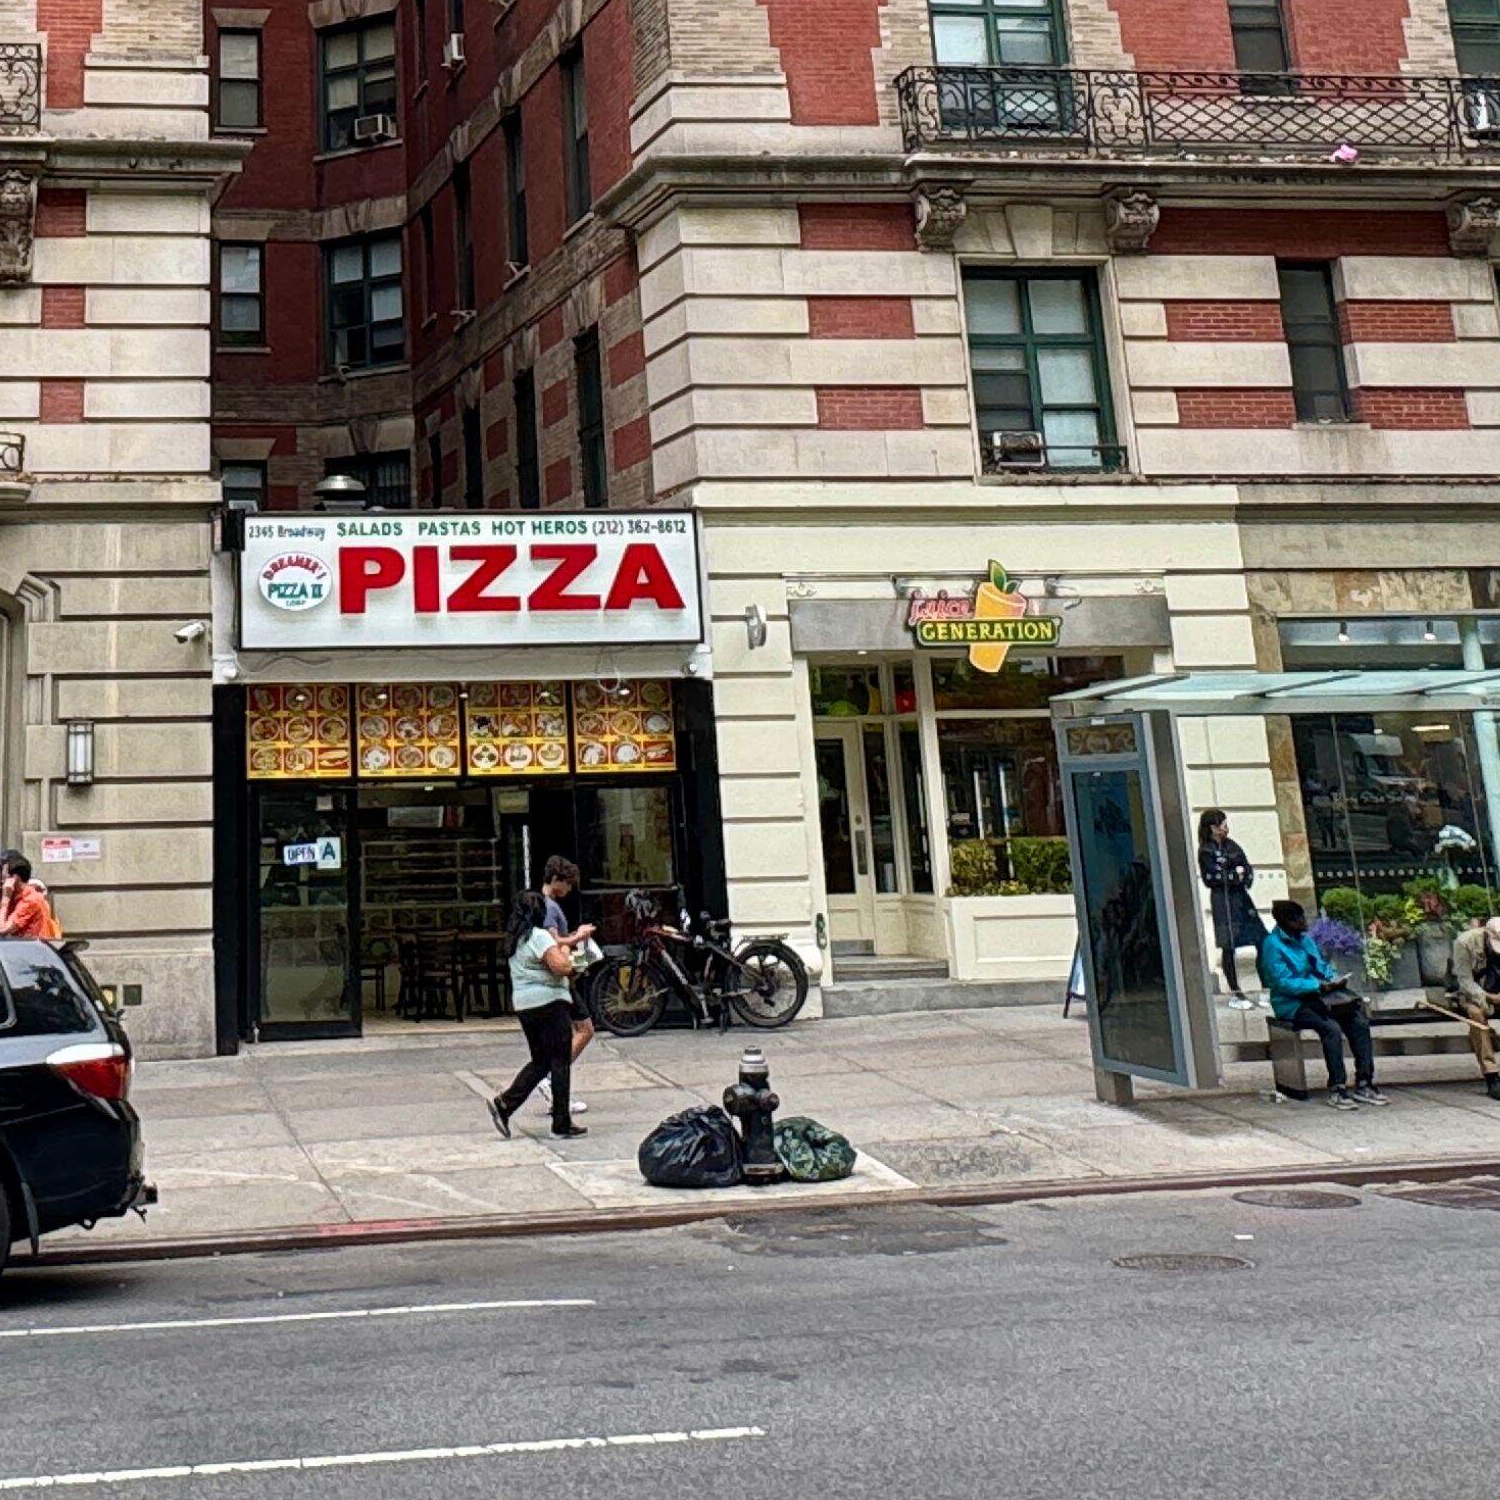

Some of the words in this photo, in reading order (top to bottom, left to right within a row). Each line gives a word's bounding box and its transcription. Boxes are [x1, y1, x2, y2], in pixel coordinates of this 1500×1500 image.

[278, 525, 326, 541] Broadway
[337, 522, 403, 537] SALADS
[418, 521, 481, 536] PASTAS
[492, 521, 525, 536] HOT
[532, 520, 588, 535] HEROS
[592, 520, 624, 536] (212)
[628, 519, 687, 534] 362-8612
[338, 543, 687, 614] PIZZA
[268, 582, 309, 599] PIZZA
[922, 621, 1052, 641] GENERATION
[322, 841, 336, 860] A
